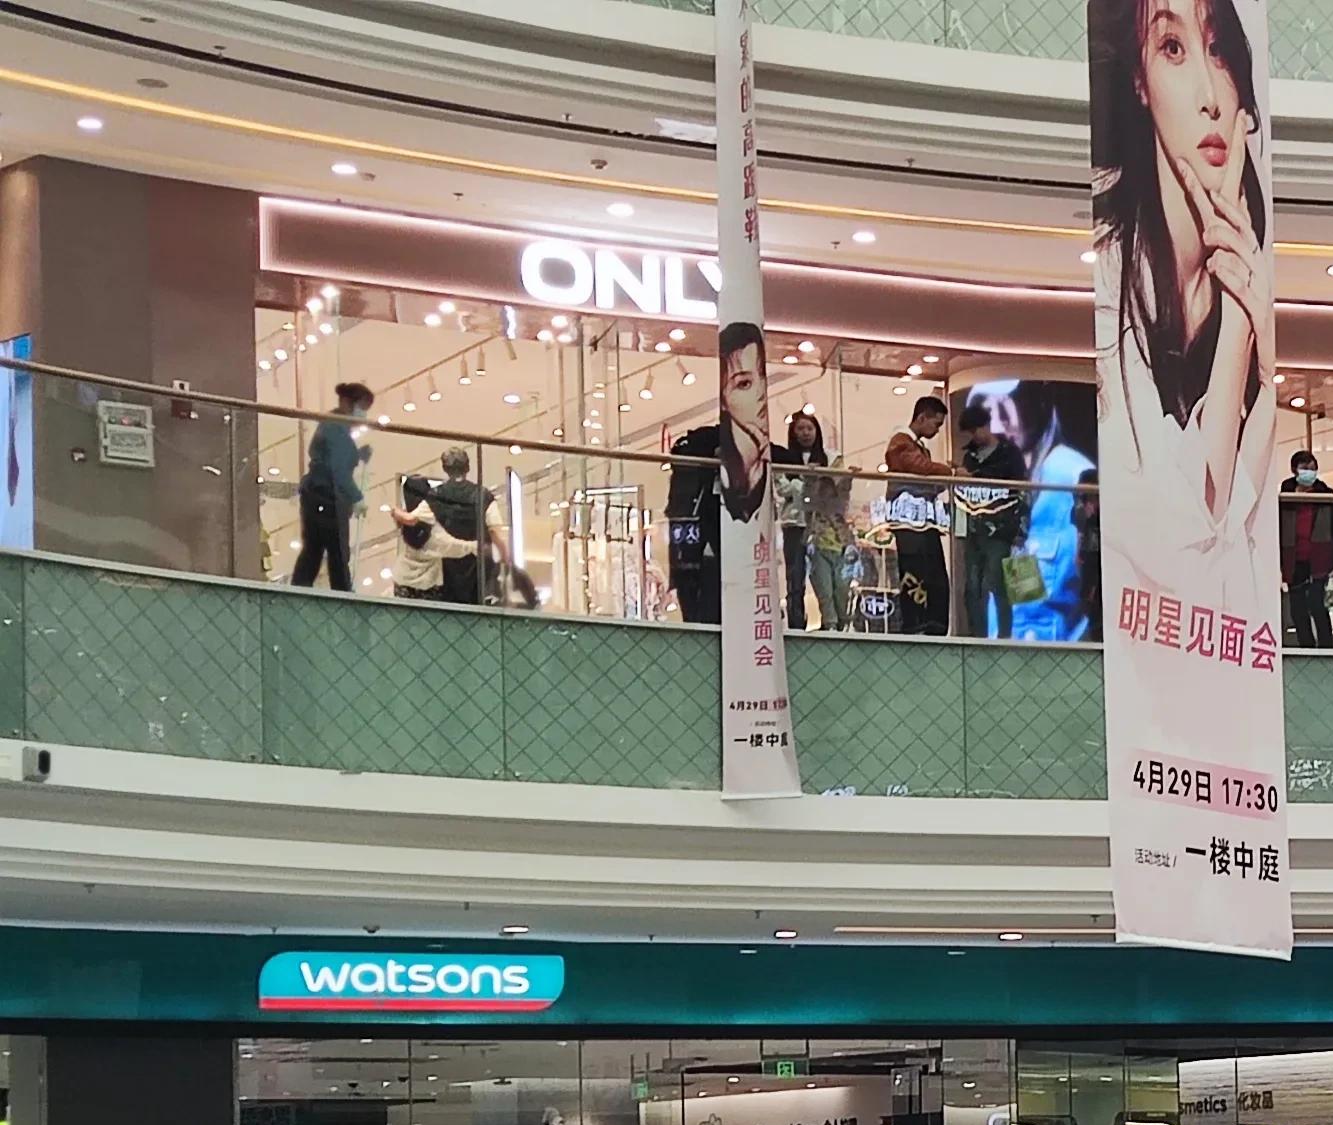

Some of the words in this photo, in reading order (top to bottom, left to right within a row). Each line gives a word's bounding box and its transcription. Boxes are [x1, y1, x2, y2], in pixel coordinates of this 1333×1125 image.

[1118, 586, 1278, 673] 明星见面会
[1133, 760, 1212, 804] 4月29日
[1222, 777, 1279, 813] 17:30
[1185, 835, 1280, 883] 一楼中庭
[300, 961, 530, 995] watsons
